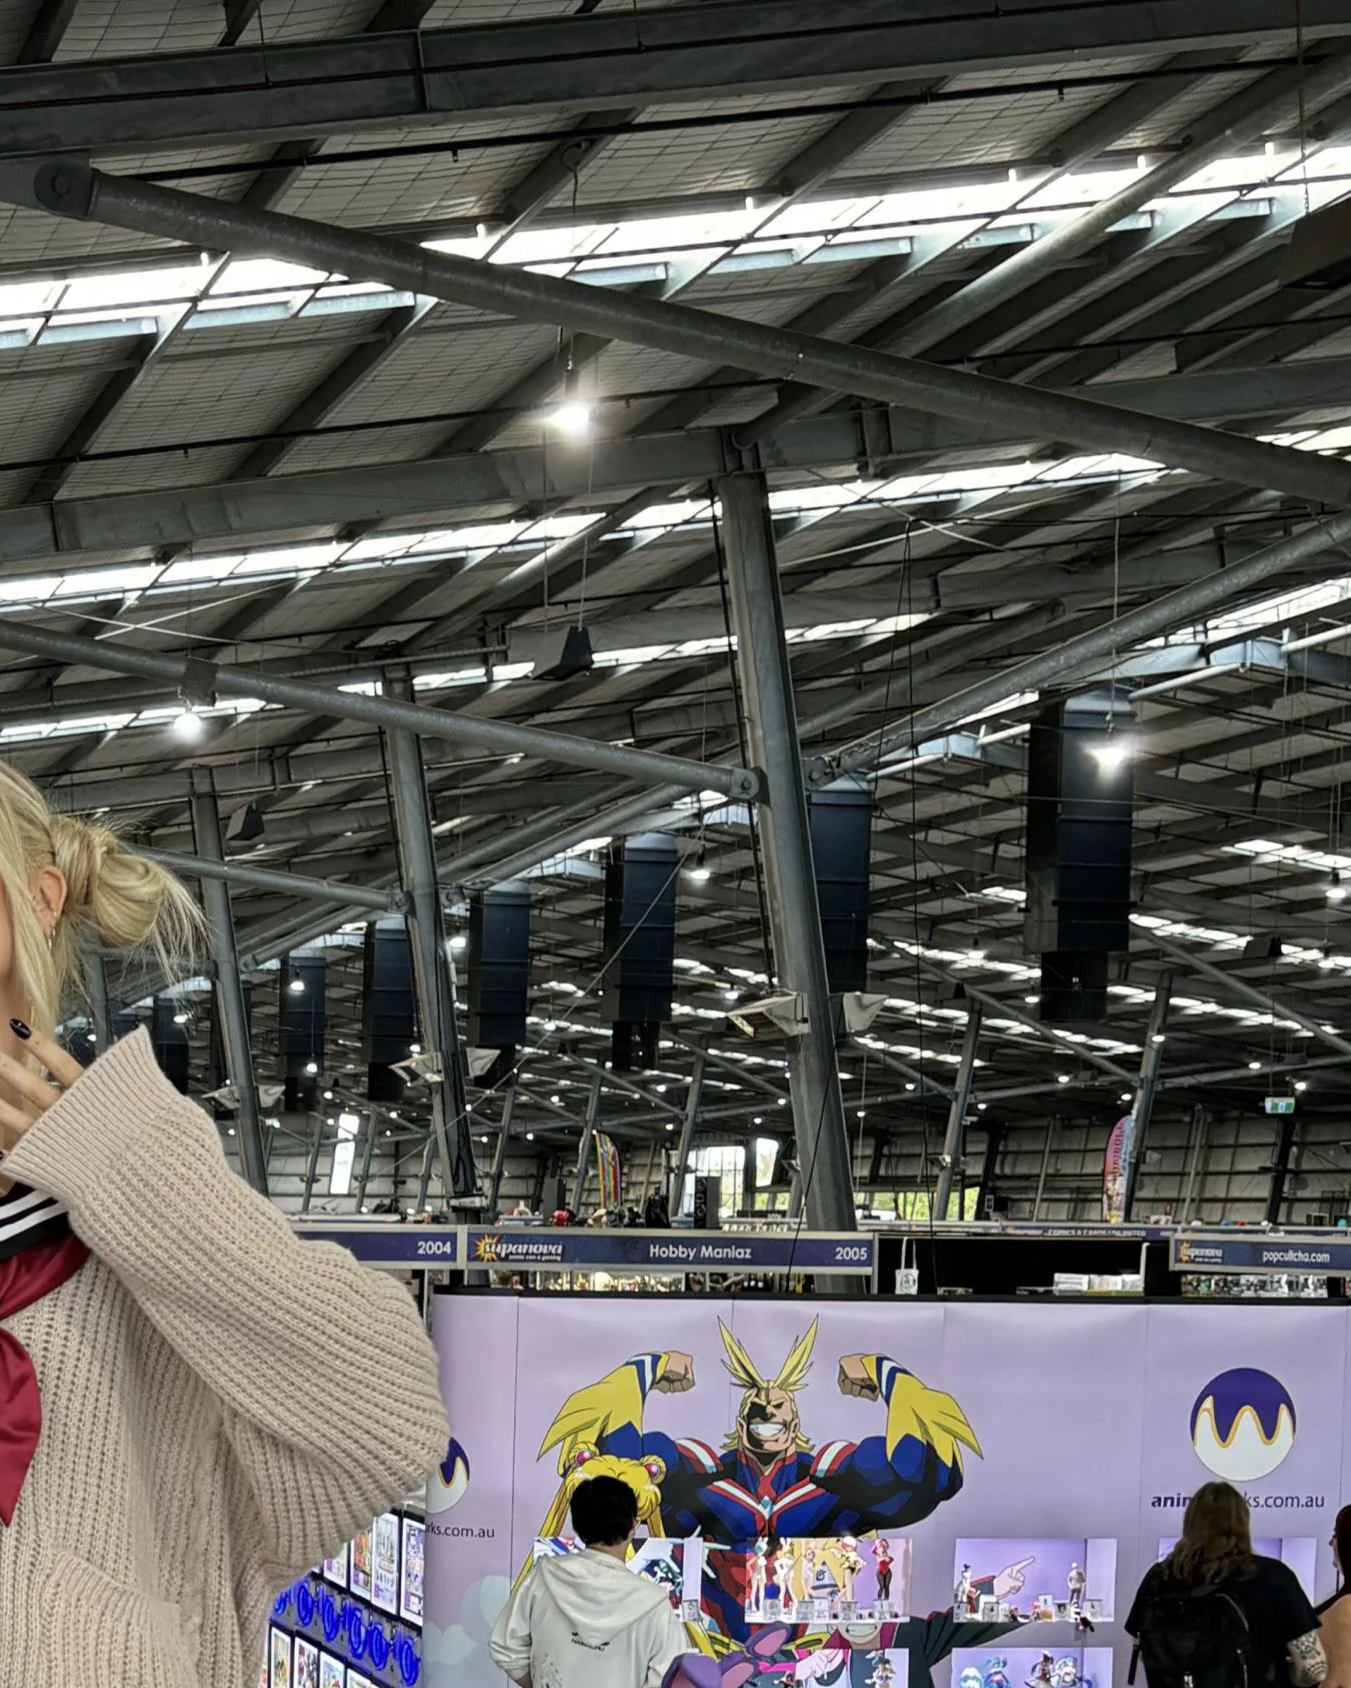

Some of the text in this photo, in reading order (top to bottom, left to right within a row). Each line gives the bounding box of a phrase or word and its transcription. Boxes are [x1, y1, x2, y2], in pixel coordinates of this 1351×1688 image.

[417, 1241, 451, 1255] 2004
[485, 1241, 564, 1259] supanova
[650, 1244, 752, 1259] Hobby Maniaz
[835, 1246, 867, 1260] 2005
